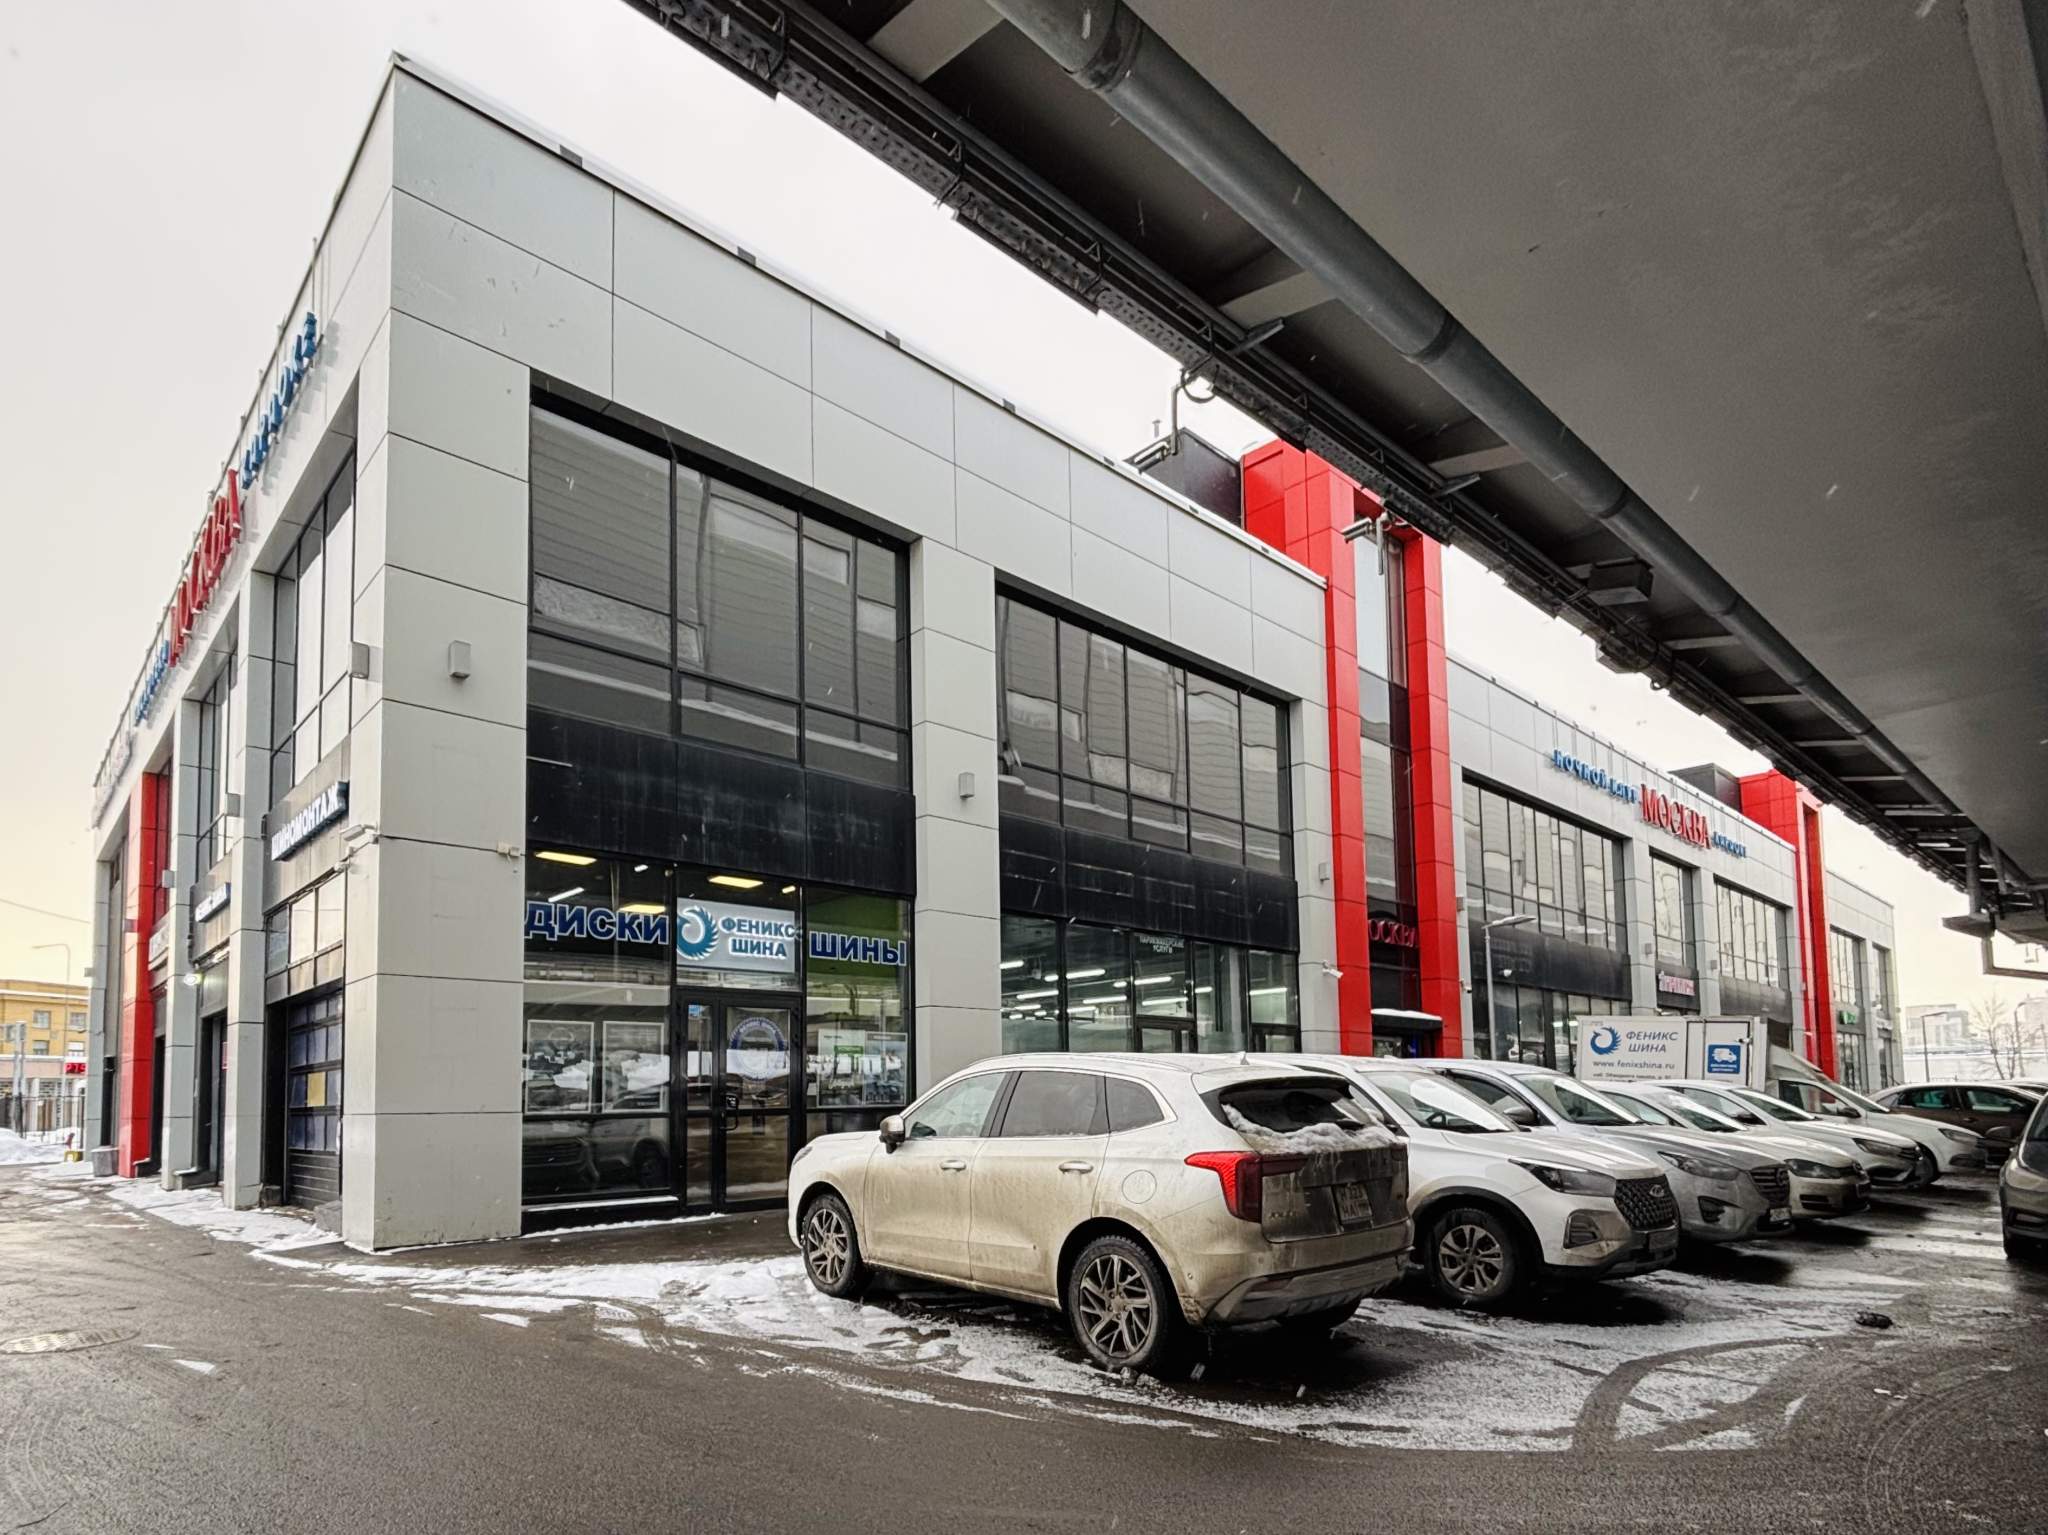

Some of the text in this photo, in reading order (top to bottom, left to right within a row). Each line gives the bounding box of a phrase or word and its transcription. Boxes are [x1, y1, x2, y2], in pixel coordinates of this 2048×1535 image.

[271, 783, 338, 861] ШИНОМОНТАЖ
[1640, 784, 1711, 849] МОСКВА
[524, 900, 669, 945] ДИСКИ
[719, 916, 797, 942] ФЕНИКС
[728, 936, 787, 960] ШИНА
[808, 931, 907, 967] ШИНЫ
[1626, 1030, 1679, 1041] ФЕНИКС
[1628, 1043, 1667, 1053] ШИНА
[1592, 1060, 1675, 1070] www.fenixshina.ru
